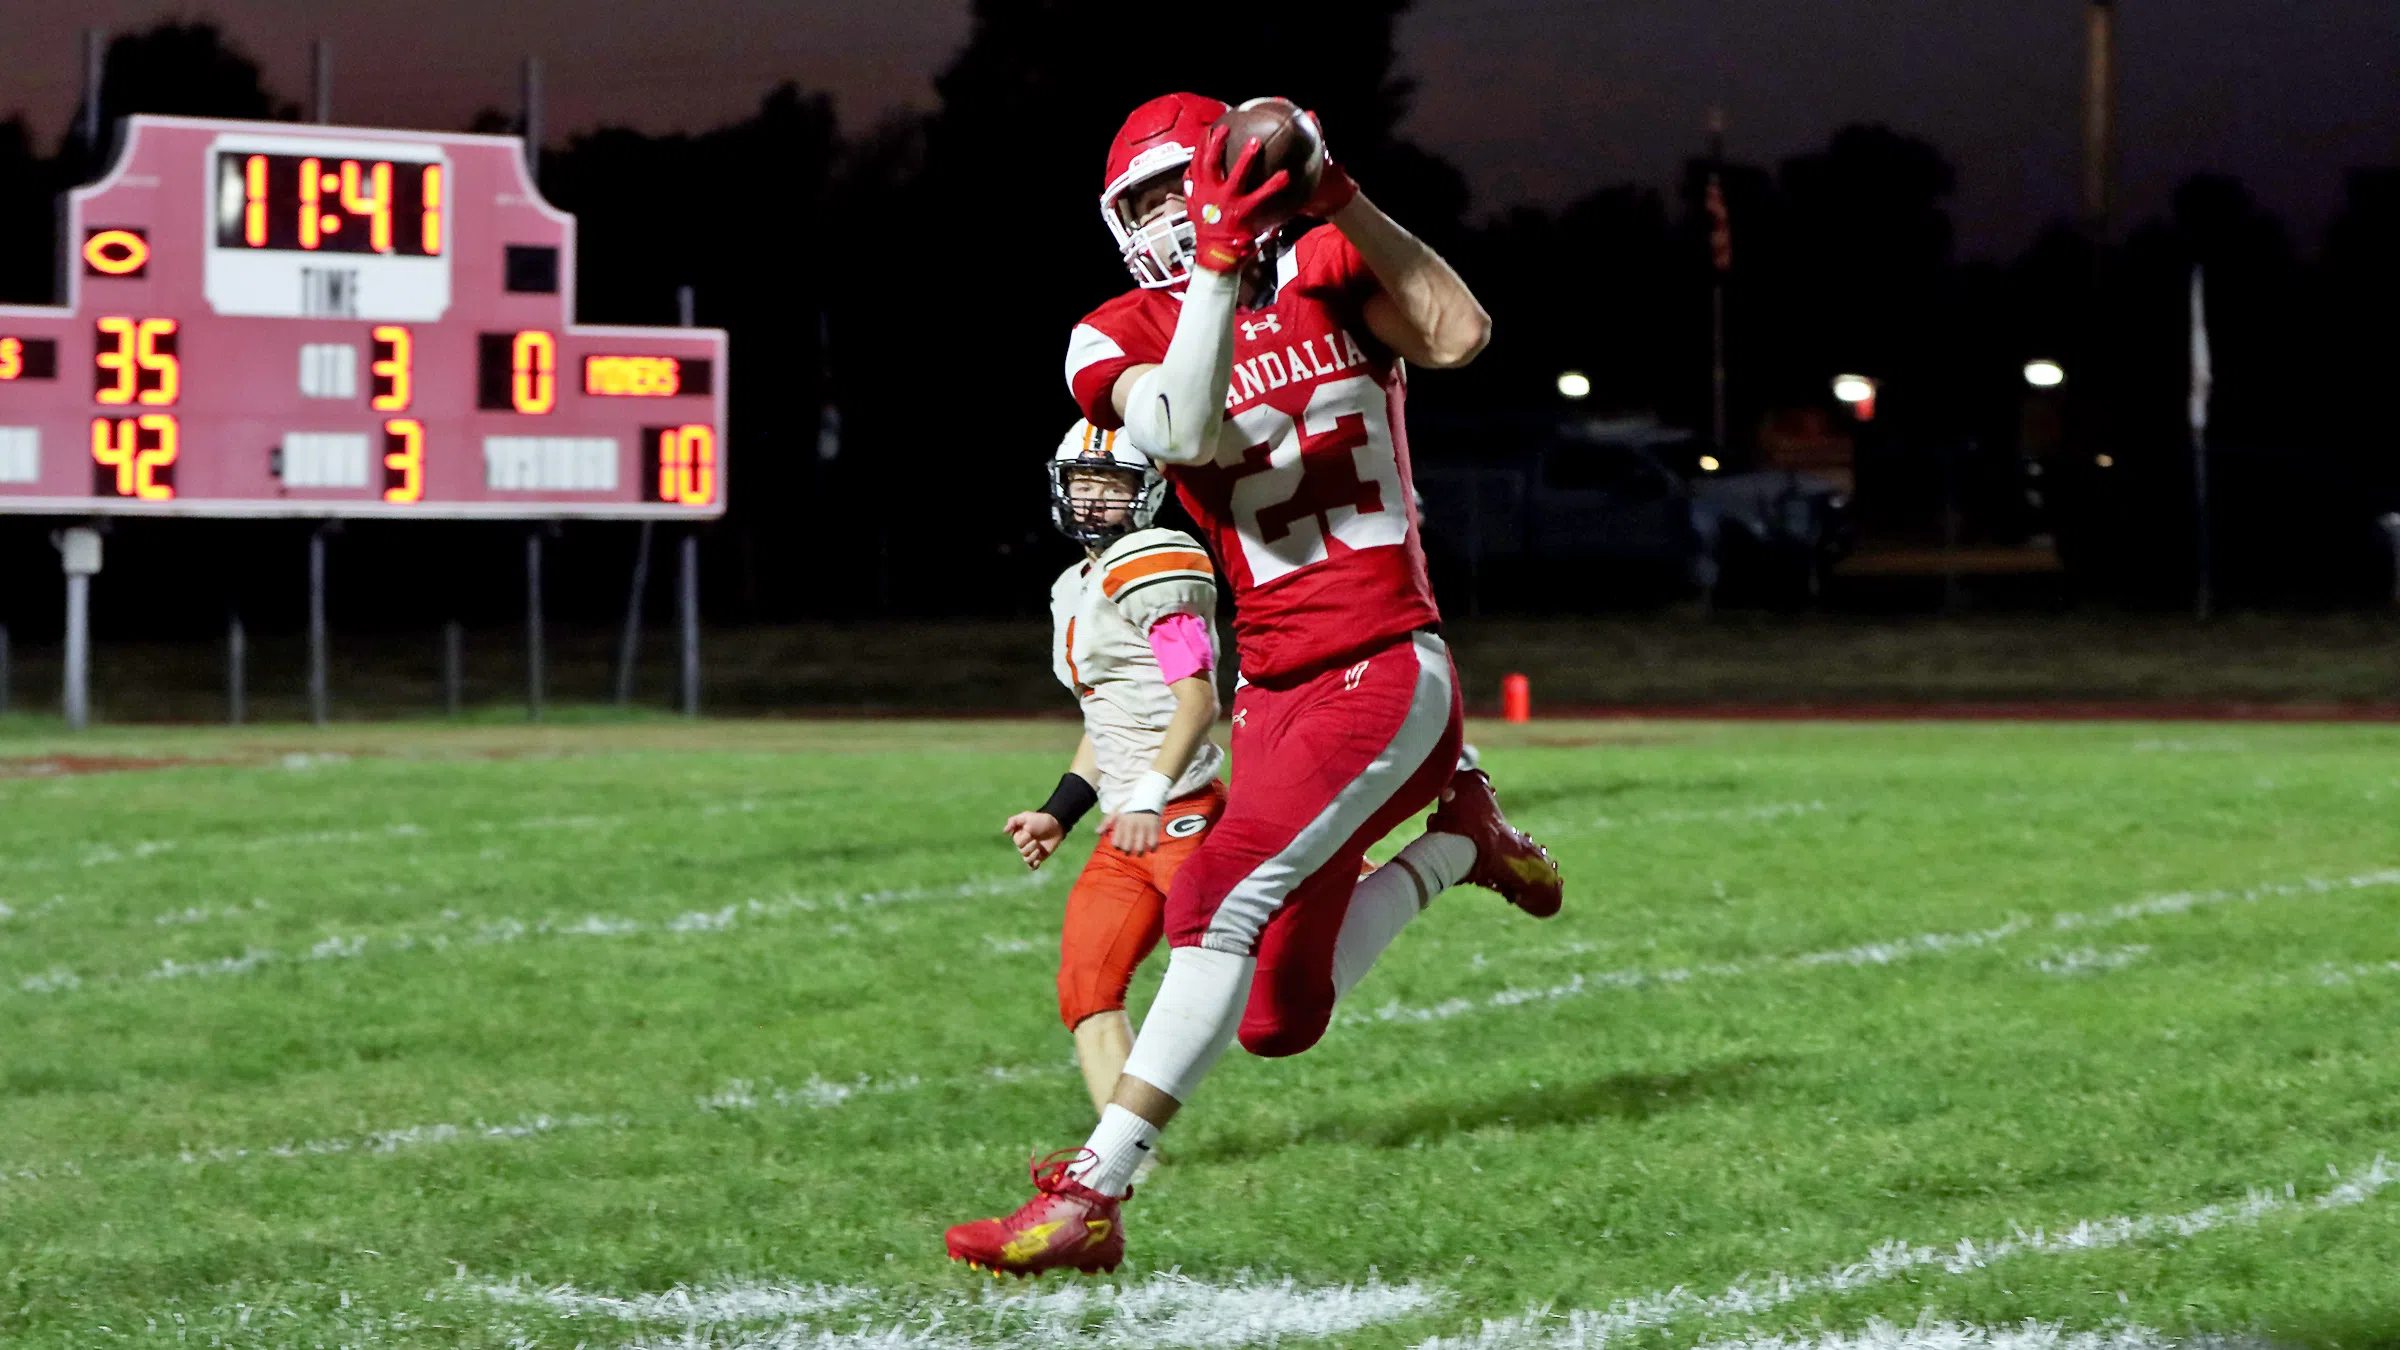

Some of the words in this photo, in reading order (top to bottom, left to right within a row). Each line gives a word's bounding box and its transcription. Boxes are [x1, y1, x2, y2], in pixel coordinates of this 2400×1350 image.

[245, 153, 444, 256] 11:41
[301, 267, 358, 319] TIME
[95, 316, 181, 406] 35
[371, 325, 413, 412] 3
[512, 330, 556, 415] 0
[91, 413, 181, 501] 42
[384, 418, 426, 505] 3
[659, 424, 716, 506] 10
[1209, 373, 1409, 587] 23
[1166, 814, 1208, 838] G
